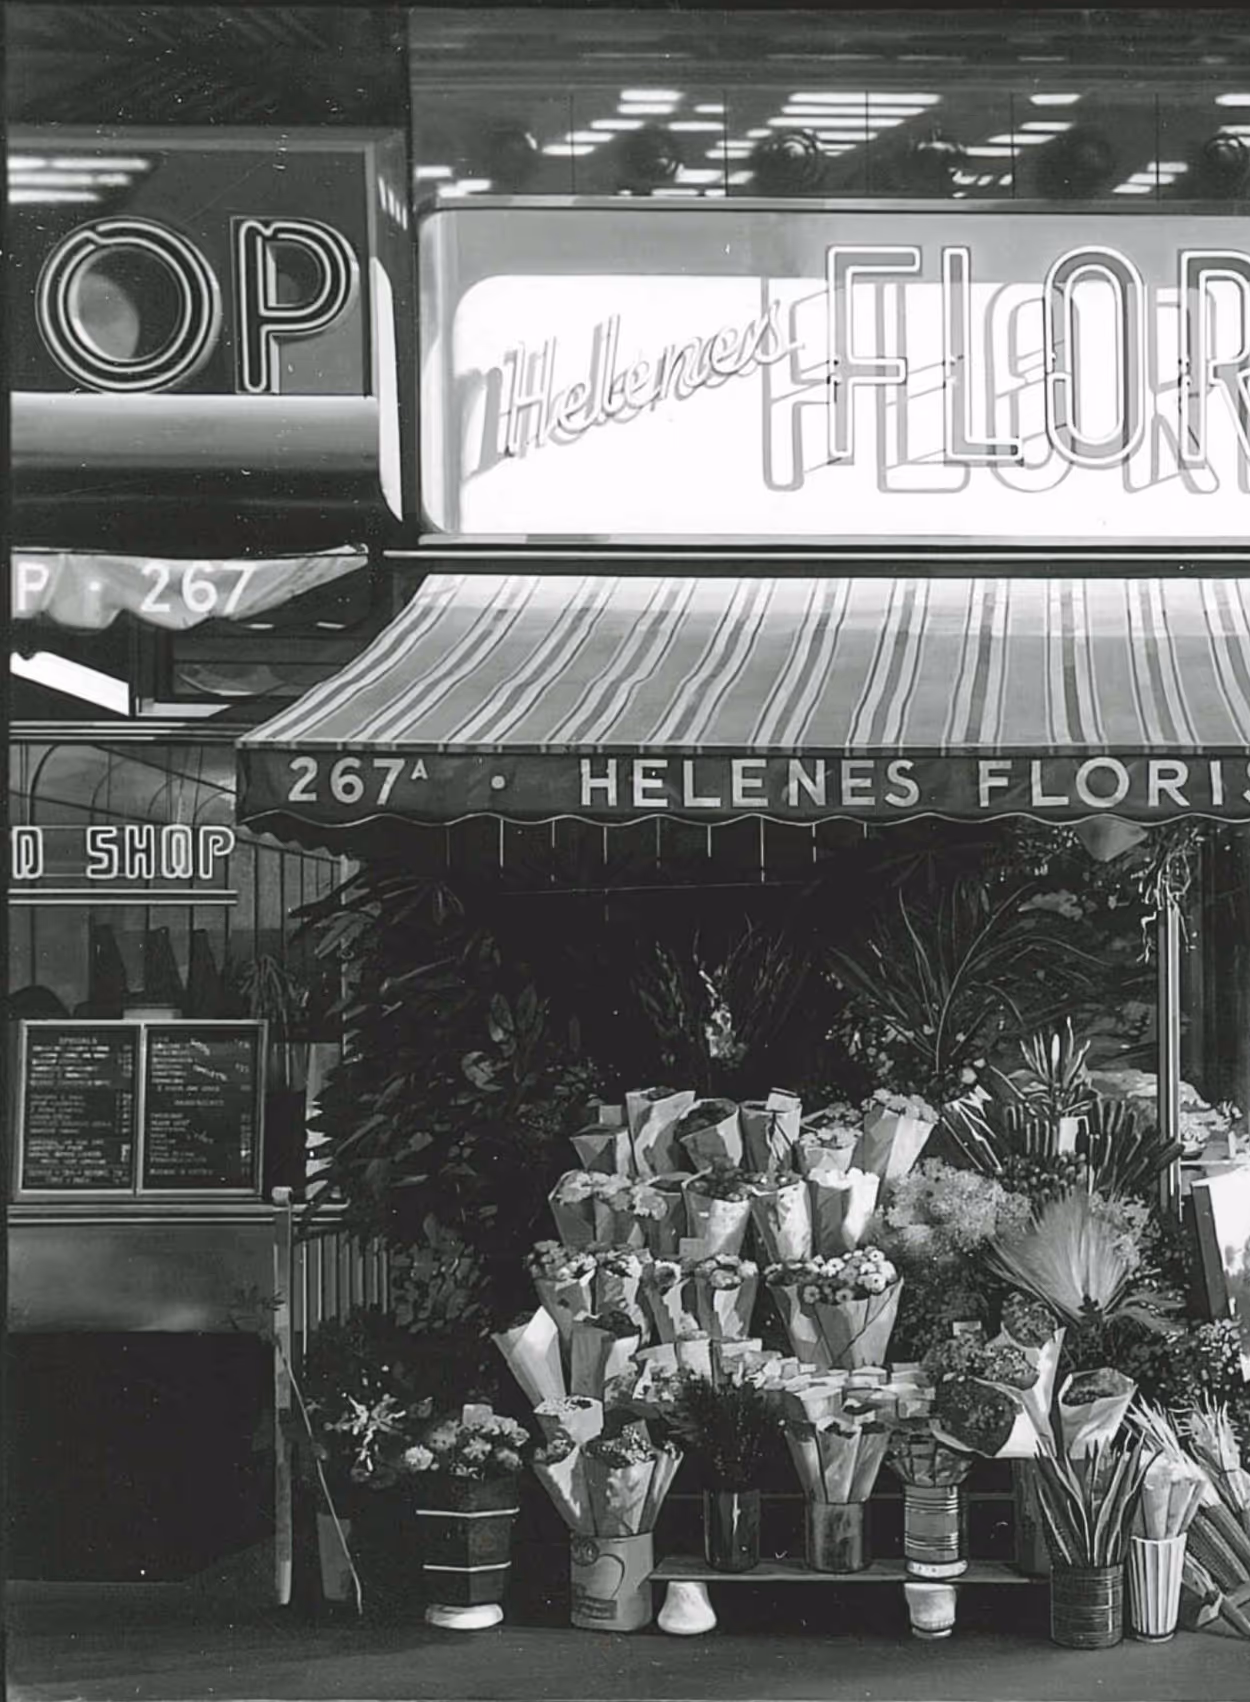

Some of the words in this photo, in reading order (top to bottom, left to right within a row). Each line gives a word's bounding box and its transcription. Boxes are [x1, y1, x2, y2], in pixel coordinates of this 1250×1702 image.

[141, 562, 257, 613] 267
[580, 757, 921, 808] HELENES
[86, 824, 235, 879] SHOP
